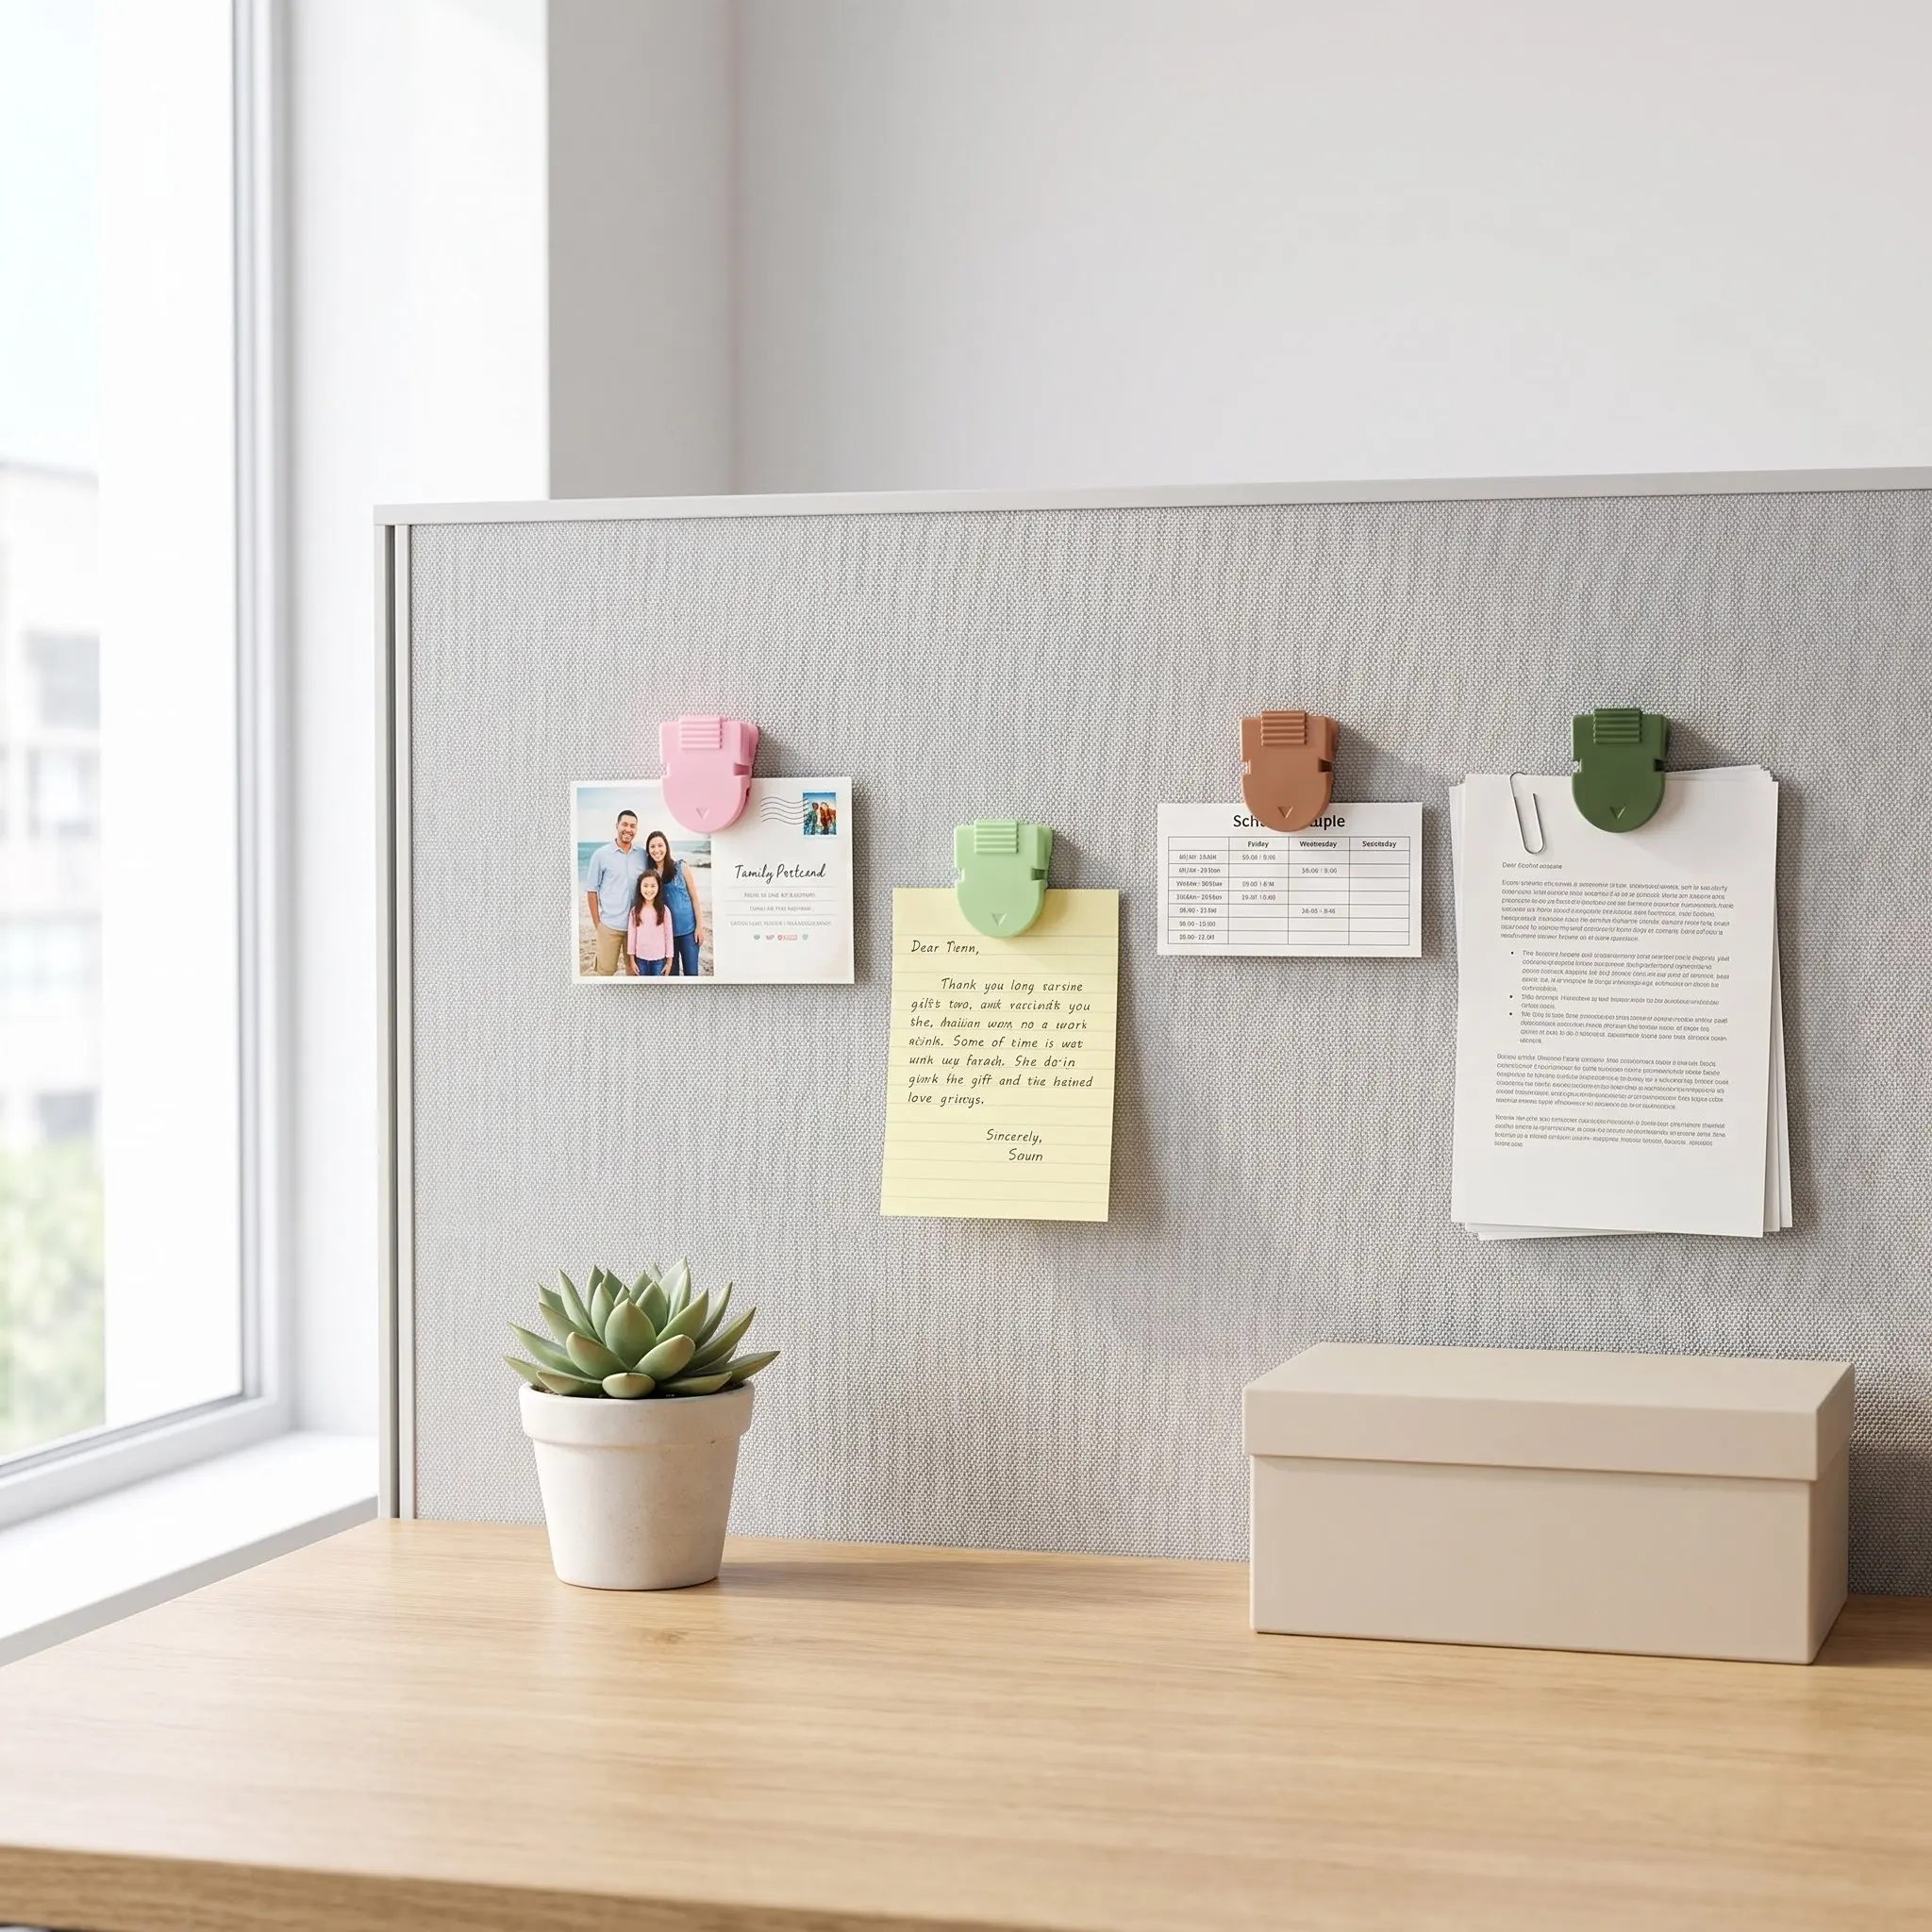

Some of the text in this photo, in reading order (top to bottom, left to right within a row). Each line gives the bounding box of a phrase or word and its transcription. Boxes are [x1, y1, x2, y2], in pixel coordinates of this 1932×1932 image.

[910, 941, 940, 953] Dear
[941, 978, 977, 991] Thank
[983, 983, 1005, 995] you
[1010, 980, 1035, 995] long
[1068, 1004, 1091, 1015] you
[953, 1035, 985, 1047] Some
[991, 1037, 1007, 1048] of
[1010, 1039, 1038, 1048] time
[1044, 1039, 1055, 1049] is
[1014, 1056, 1037, 1067] She
[971, 1074, 993, 1090] gift
[998, 1074, 1022, 1086] and
[908, 1091, 932, 1104] love
[986, 1129, 1042, 1146] Sincerely,
